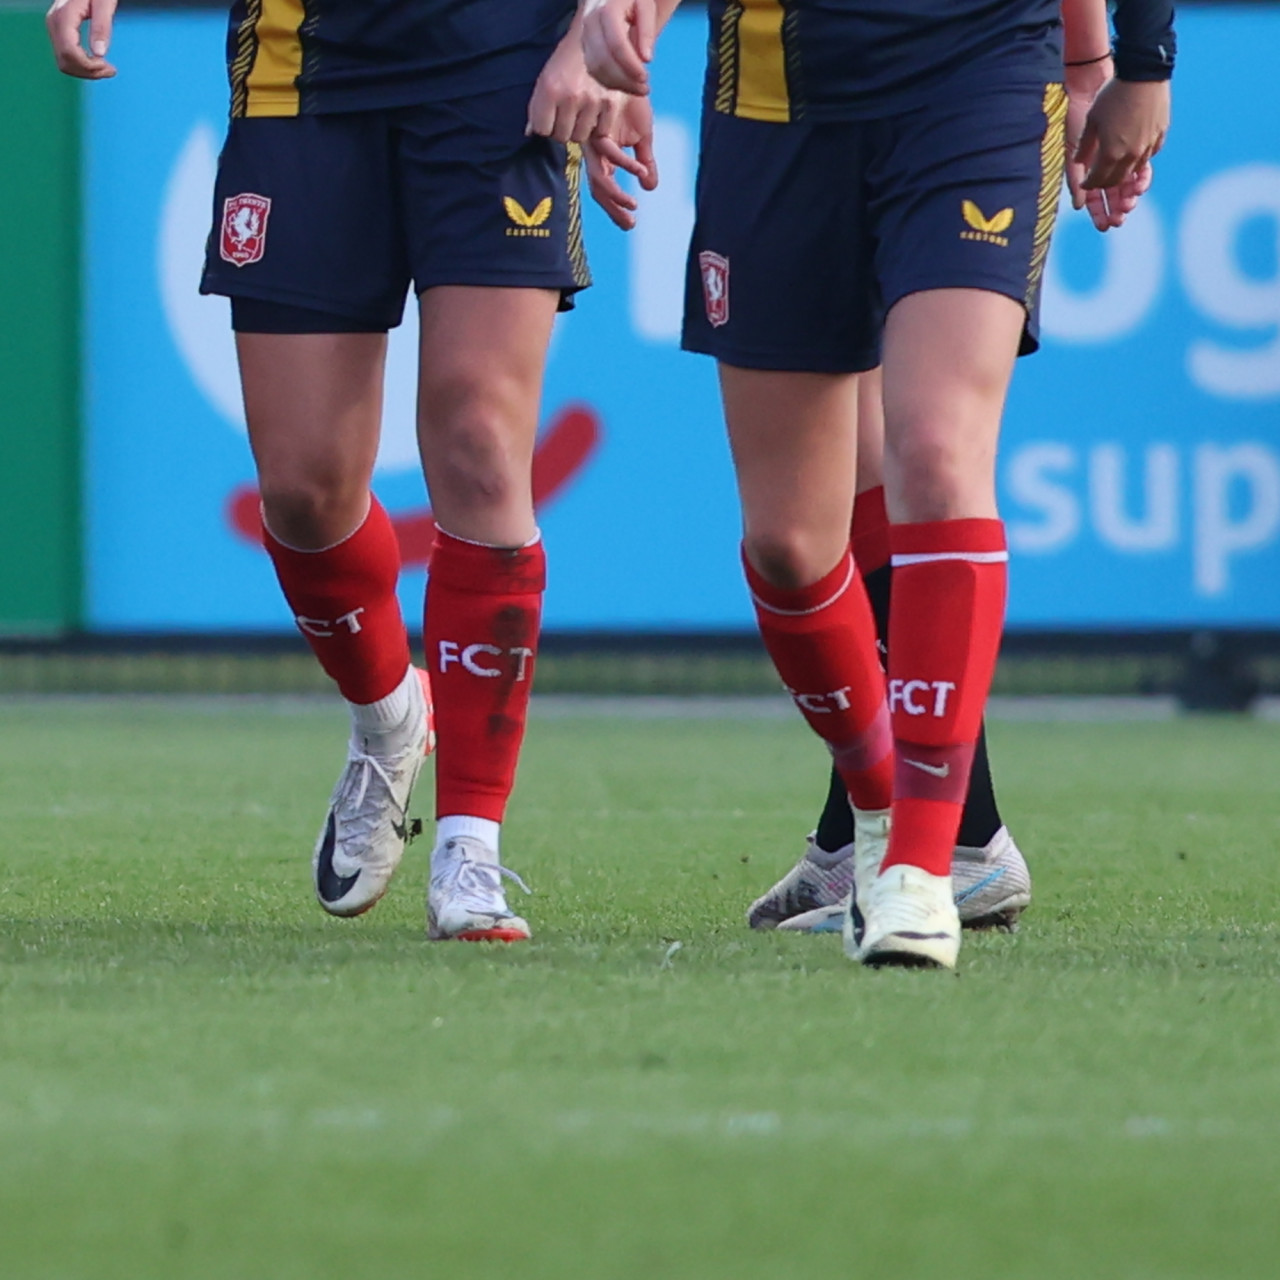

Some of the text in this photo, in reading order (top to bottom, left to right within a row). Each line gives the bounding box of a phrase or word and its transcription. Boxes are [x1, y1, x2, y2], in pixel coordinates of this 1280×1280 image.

[1006, 439, 1280, 596] sup
[296, 607, 365, 637] CT
[438, 639, 533, 682] FCT
[783, 684, 852, 714] CT
[888, 678, 956, 718] FCT
